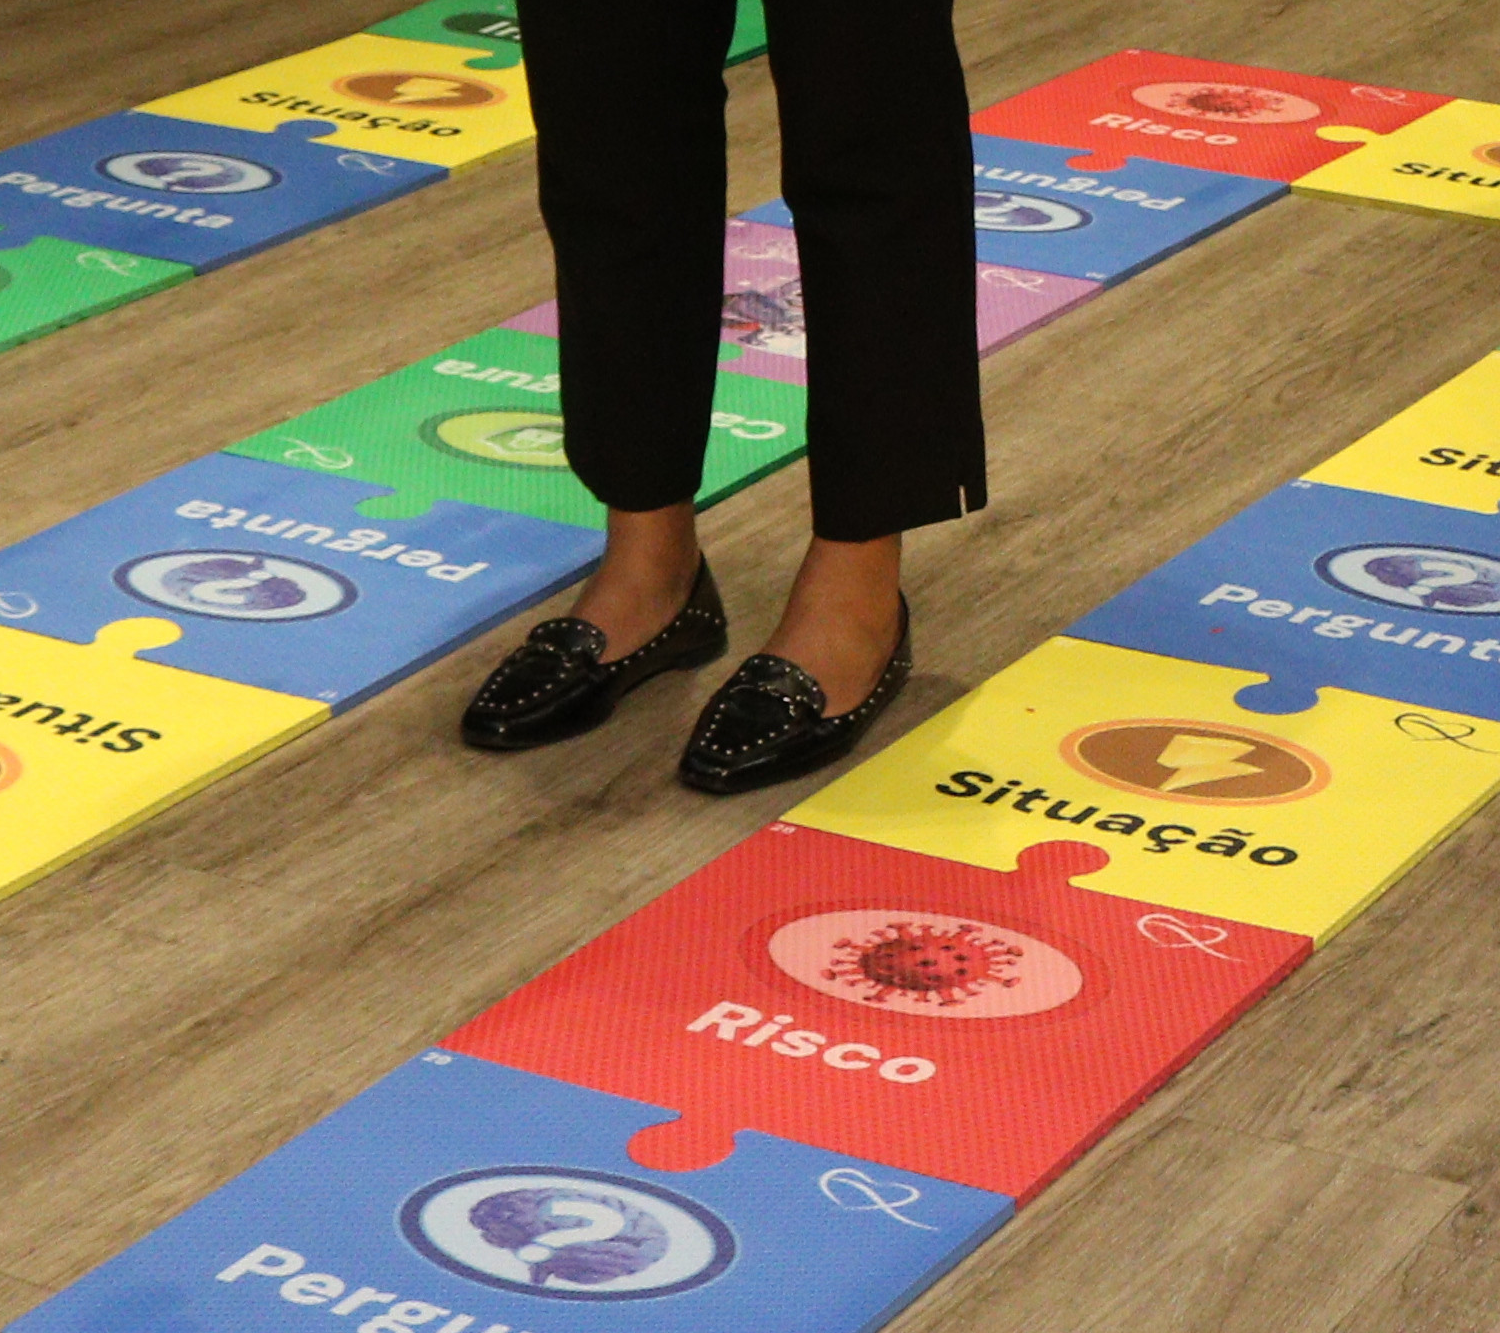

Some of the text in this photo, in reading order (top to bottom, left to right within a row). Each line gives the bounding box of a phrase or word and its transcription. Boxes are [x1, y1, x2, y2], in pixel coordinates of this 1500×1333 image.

[238, 88, 463, 139] Situação
[1088, 113, 1238, 146] Risco
[974, 161, 1186, 213] Pergun
[175, 497, 488, 584] Pergunta
[934, 767, 1300, 871] Situação
[685, 1001, 937, 1085] Risco
